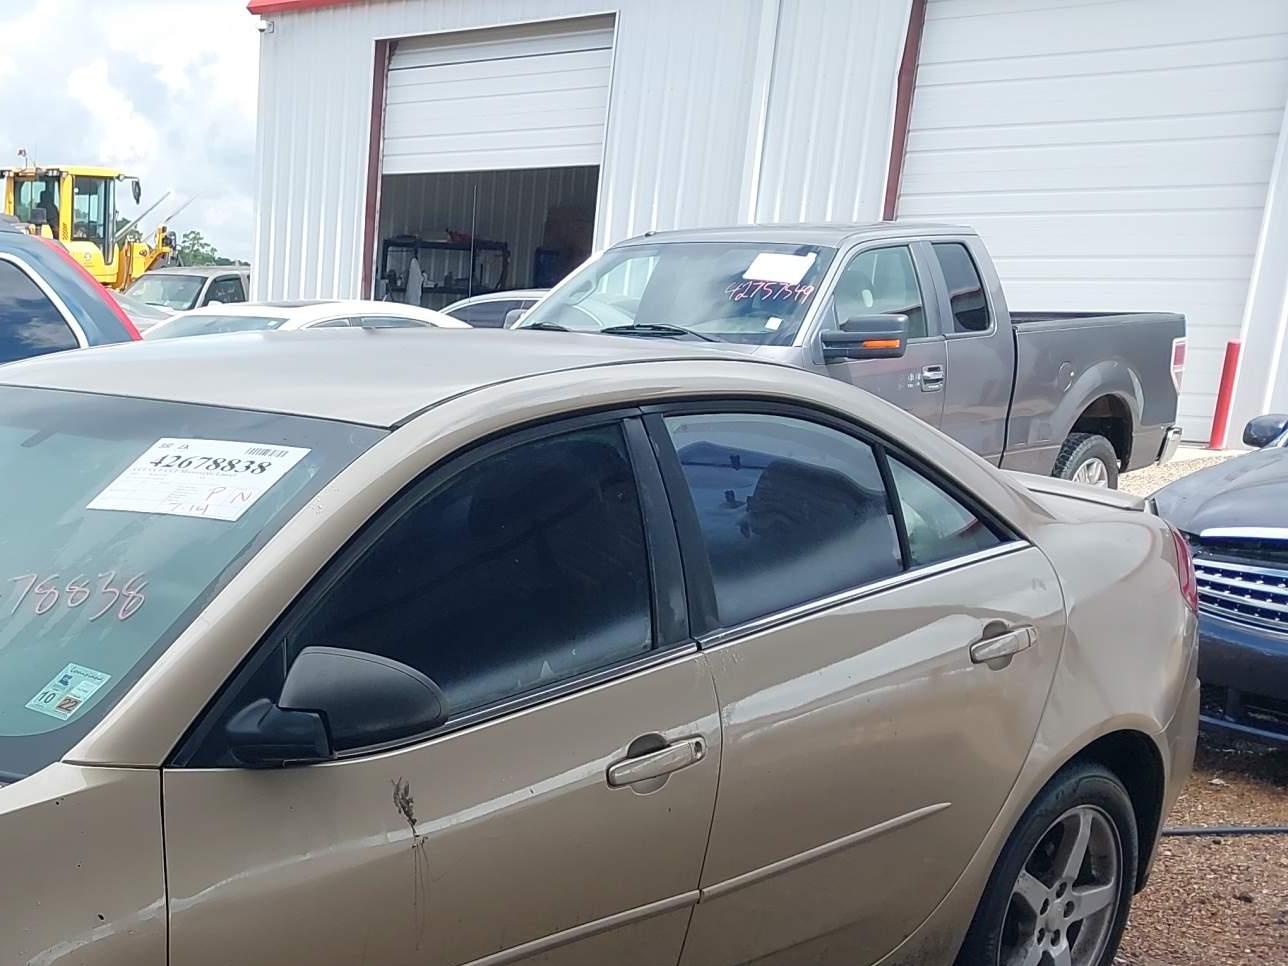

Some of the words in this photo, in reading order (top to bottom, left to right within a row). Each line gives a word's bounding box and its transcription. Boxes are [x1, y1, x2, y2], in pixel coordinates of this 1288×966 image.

[724, 280, 815, 304] 42757549
[149, 453, 273, 475] 42678838
[38, 690, 56, 704] 10
[57, 698, 78, 712] 22
